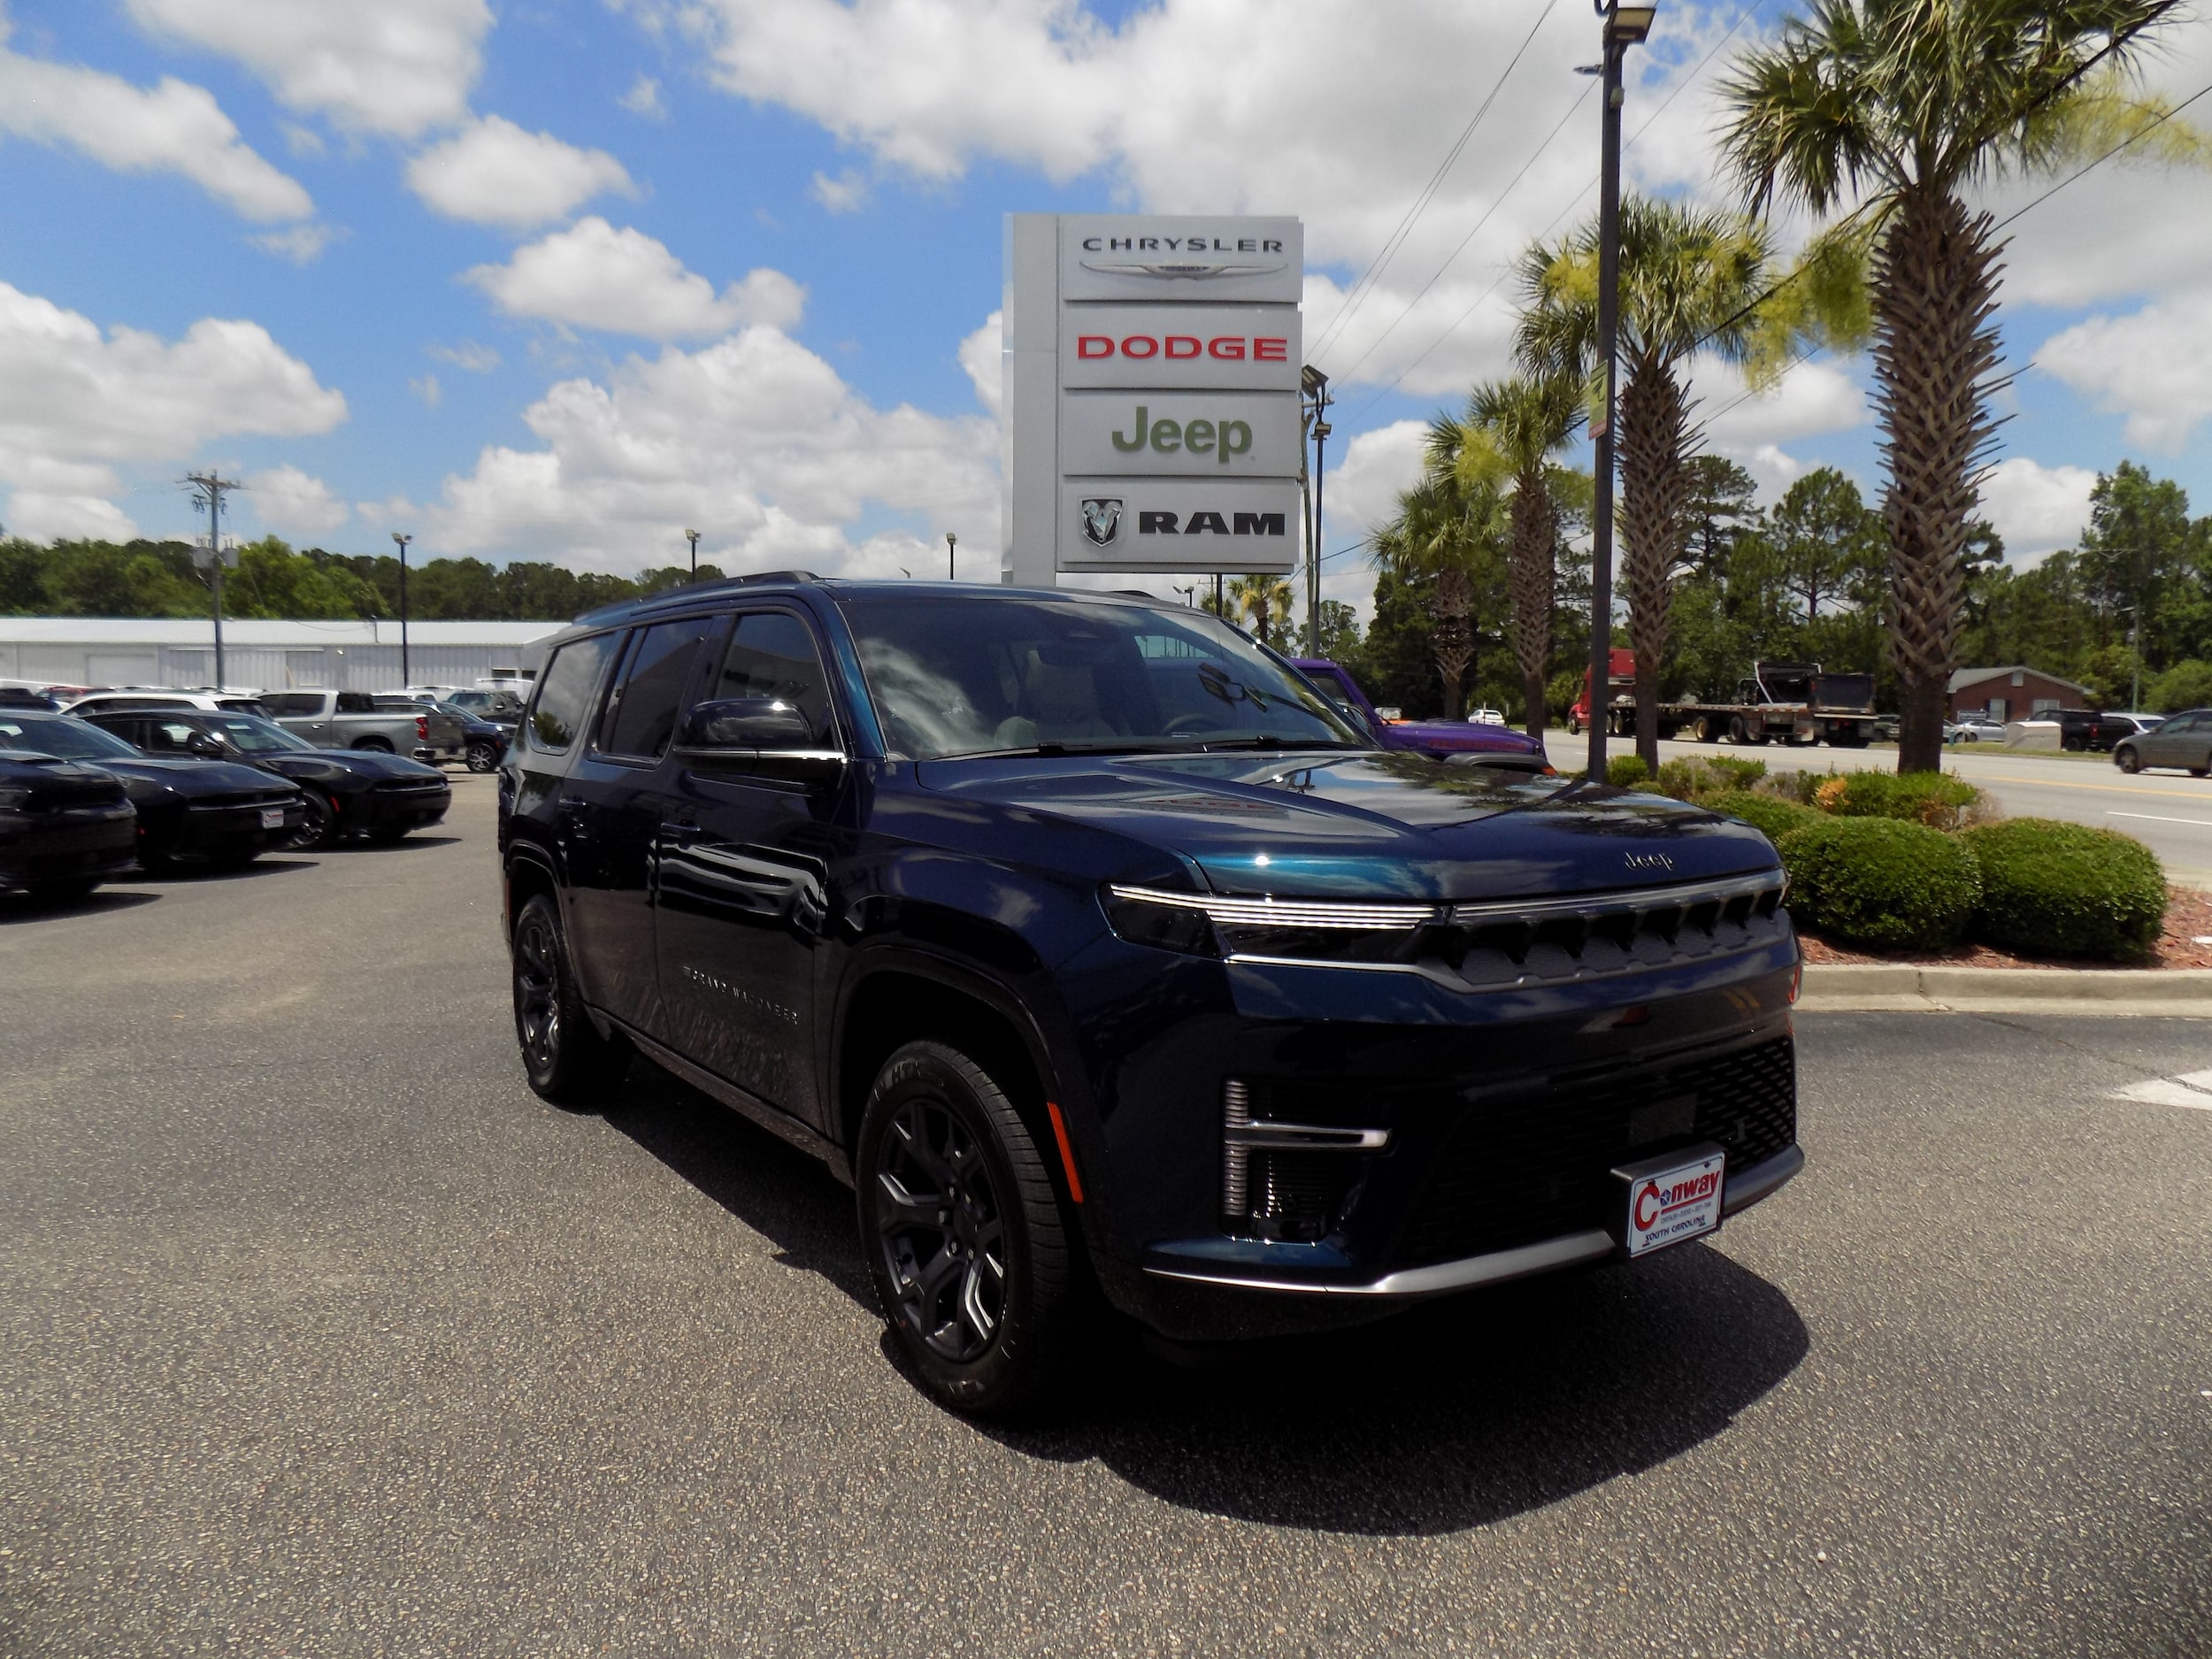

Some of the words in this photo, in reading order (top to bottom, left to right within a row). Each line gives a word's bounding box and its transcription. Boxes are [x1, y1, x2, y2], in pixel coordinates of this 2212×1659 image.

[1082, 237, 1283, 253] CHRYSLER
[1078, 335, 1287, 362] DODGE
[1111, 406, 1253, 465] Jeep
[1139, 511, 1286, 535] RAM
[1624, 852, 1673, 872] Jeep
[1645, 1226, 1670, 1242] SOUTH
[1671, 1215, 1706, 1233] CAROLINA
